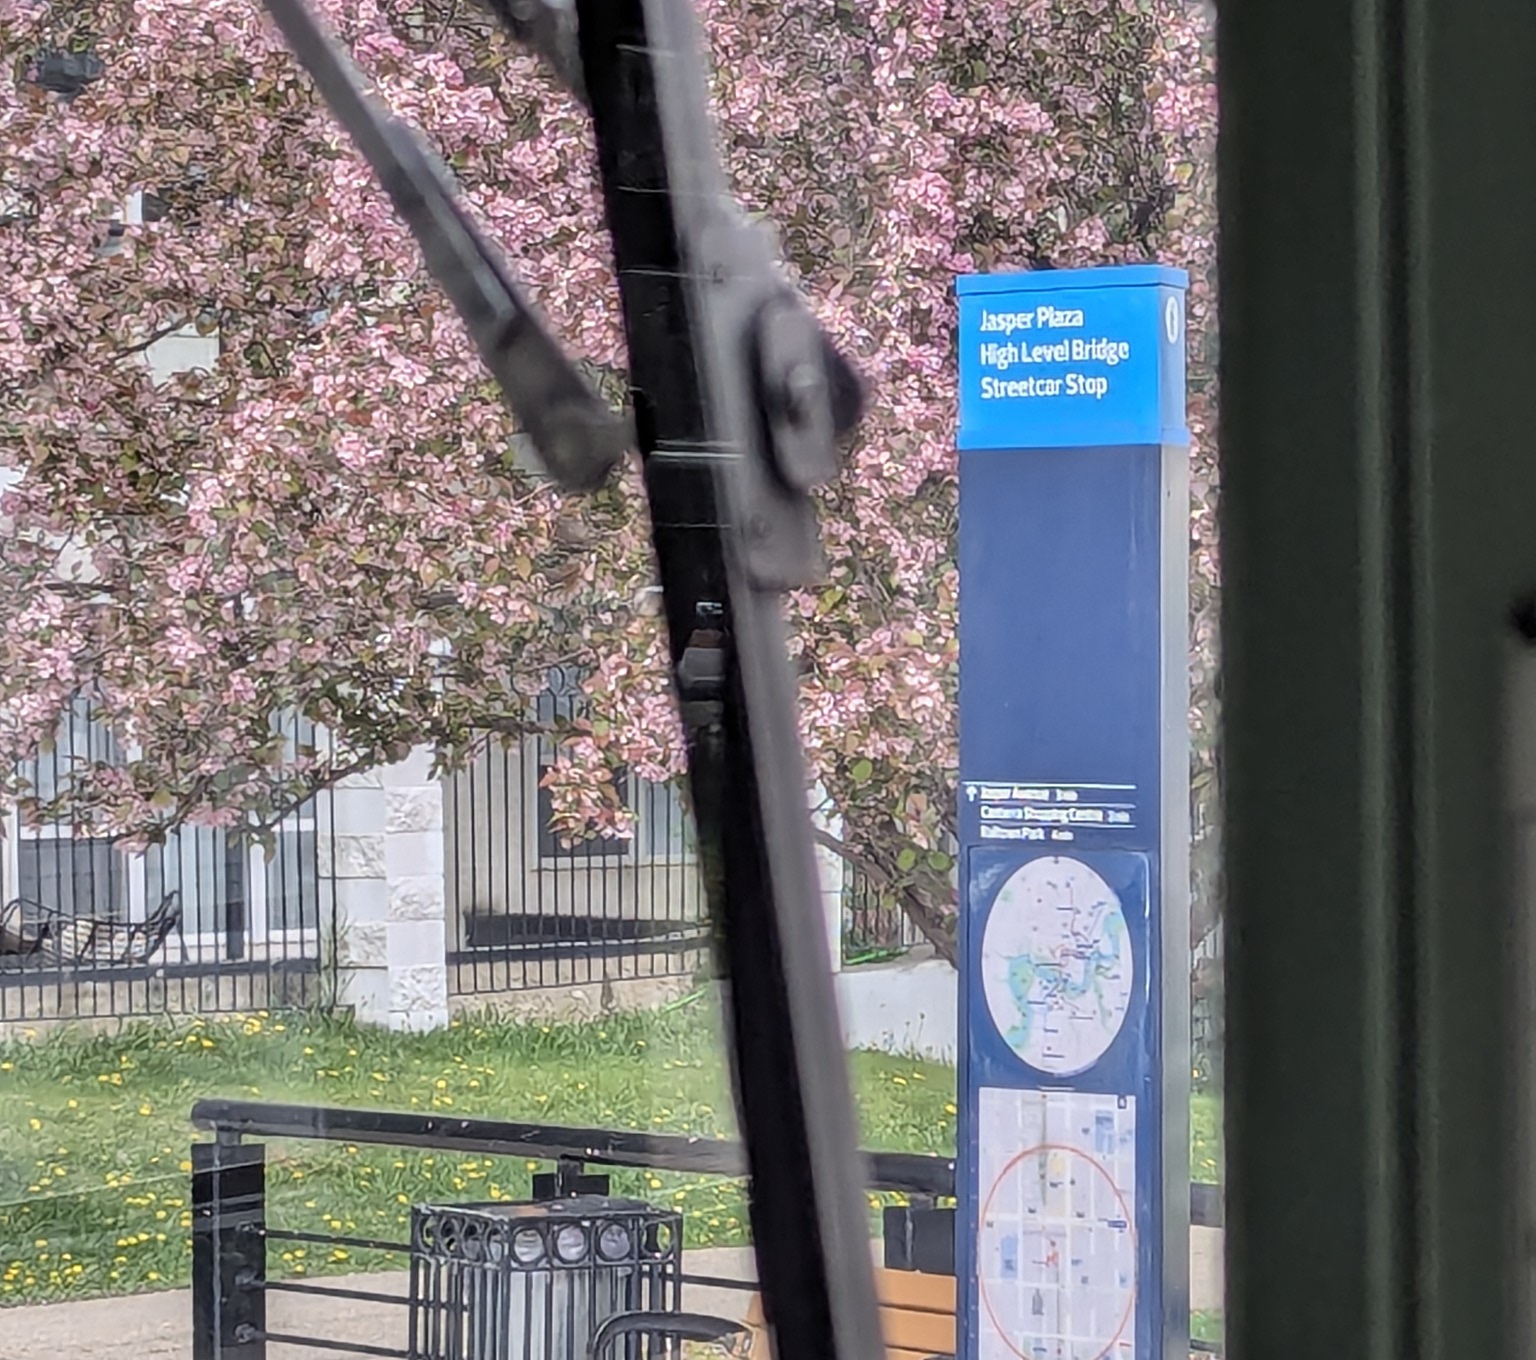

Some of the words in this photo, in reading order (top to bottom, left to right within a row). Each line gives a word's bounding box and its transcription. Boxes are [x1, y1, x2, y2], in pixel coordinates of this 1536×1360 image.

[979, 309, 1034, 336] Jasper
[1036, 305, 1084, 329] Plaza
[980, 342, 1019, 370] High
[1020, 339, 1070, 363] Level
[1071, 337, 1130, 366] Bridge
[980, 376, 1063, 399] Streetcar
[1064, 373, 1108, 400] Stop
